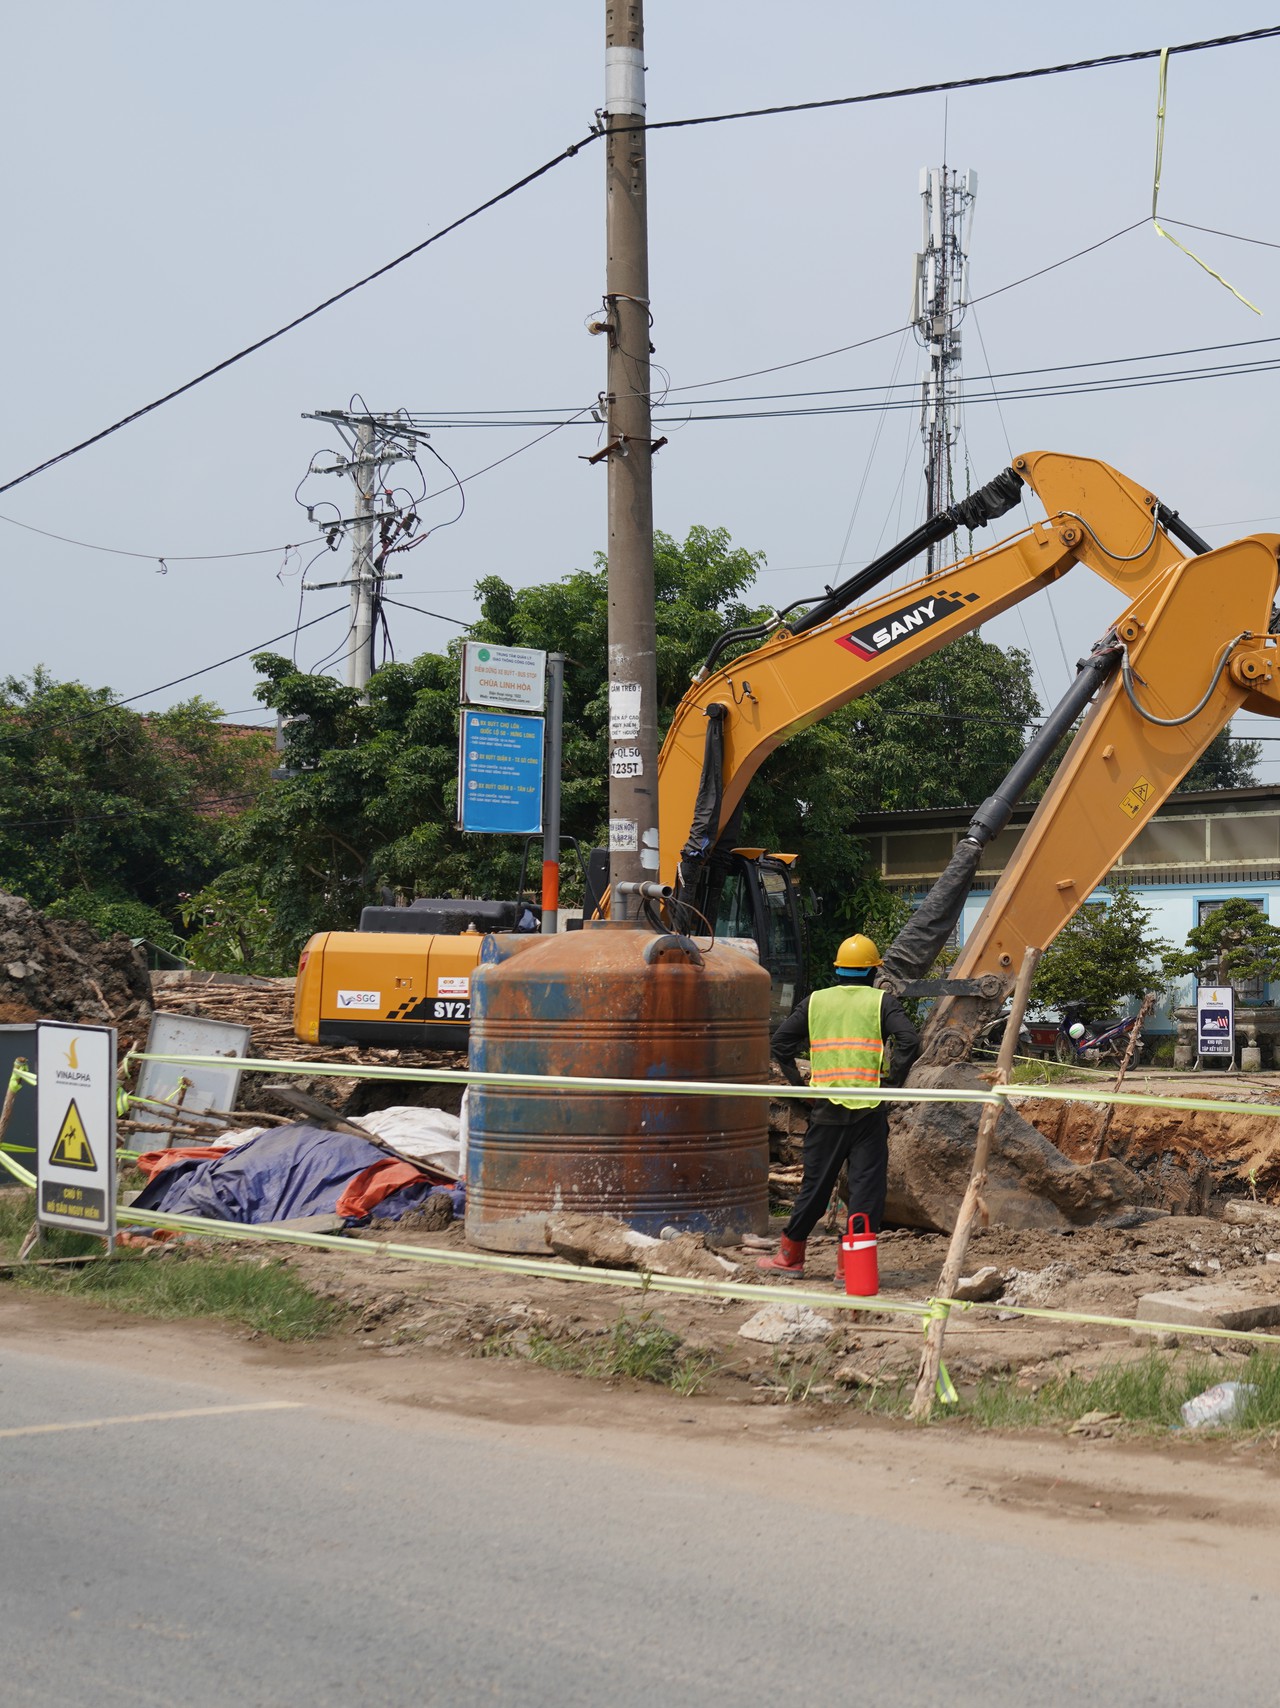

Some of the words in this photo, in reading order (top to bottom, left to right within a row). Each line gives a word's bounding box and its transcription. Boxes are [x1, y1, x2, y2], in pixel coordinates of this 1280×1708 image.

[872, 600, 936, 649] SANY
[500, 682, 515, 690] LINH
[356, 994, 376, 1002] SGC
[56, 1070, 91, 1081] VINALPHA
